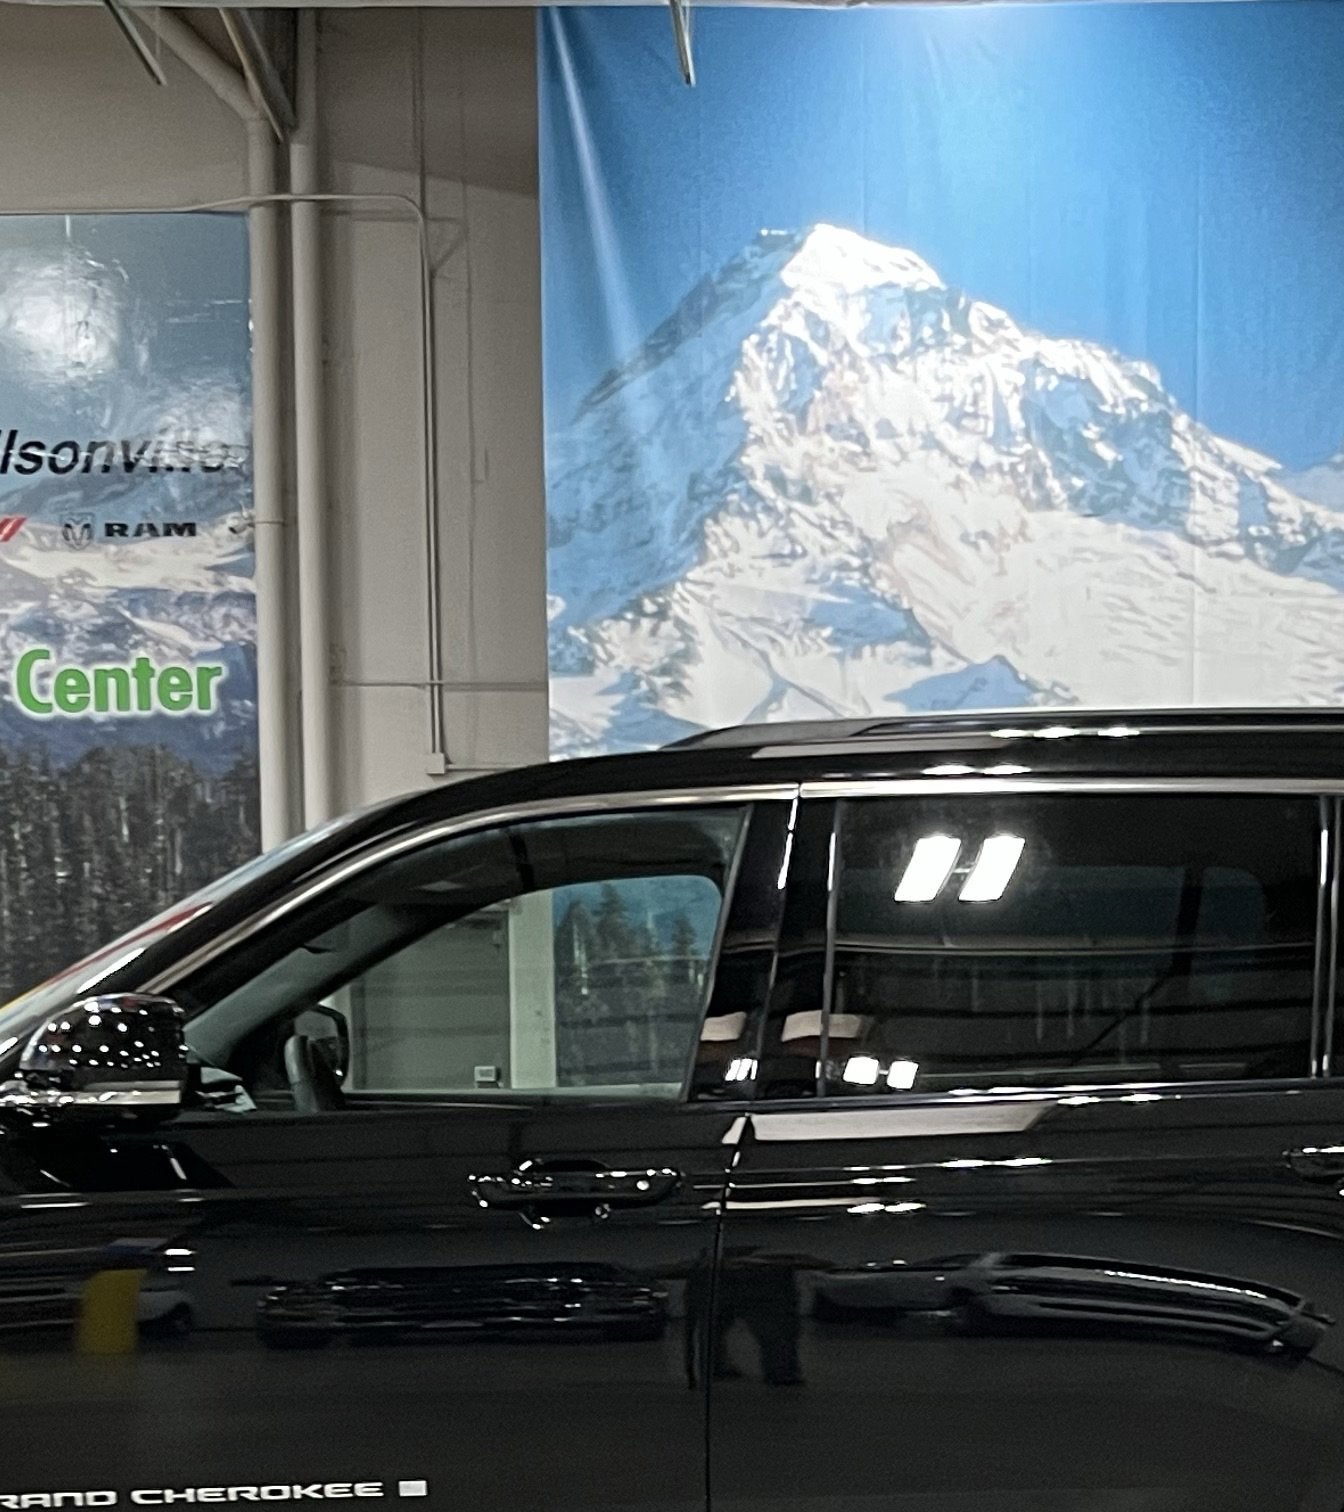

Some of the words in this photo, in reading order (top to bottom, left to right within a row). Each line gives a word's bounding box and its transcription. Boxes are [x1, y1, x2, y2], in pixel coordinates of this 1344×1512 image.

[104, 521, 198, 538] RAM
[15, 647, 224, 716] Center
[130, 1481, 384, 1505] CHEROKEE
